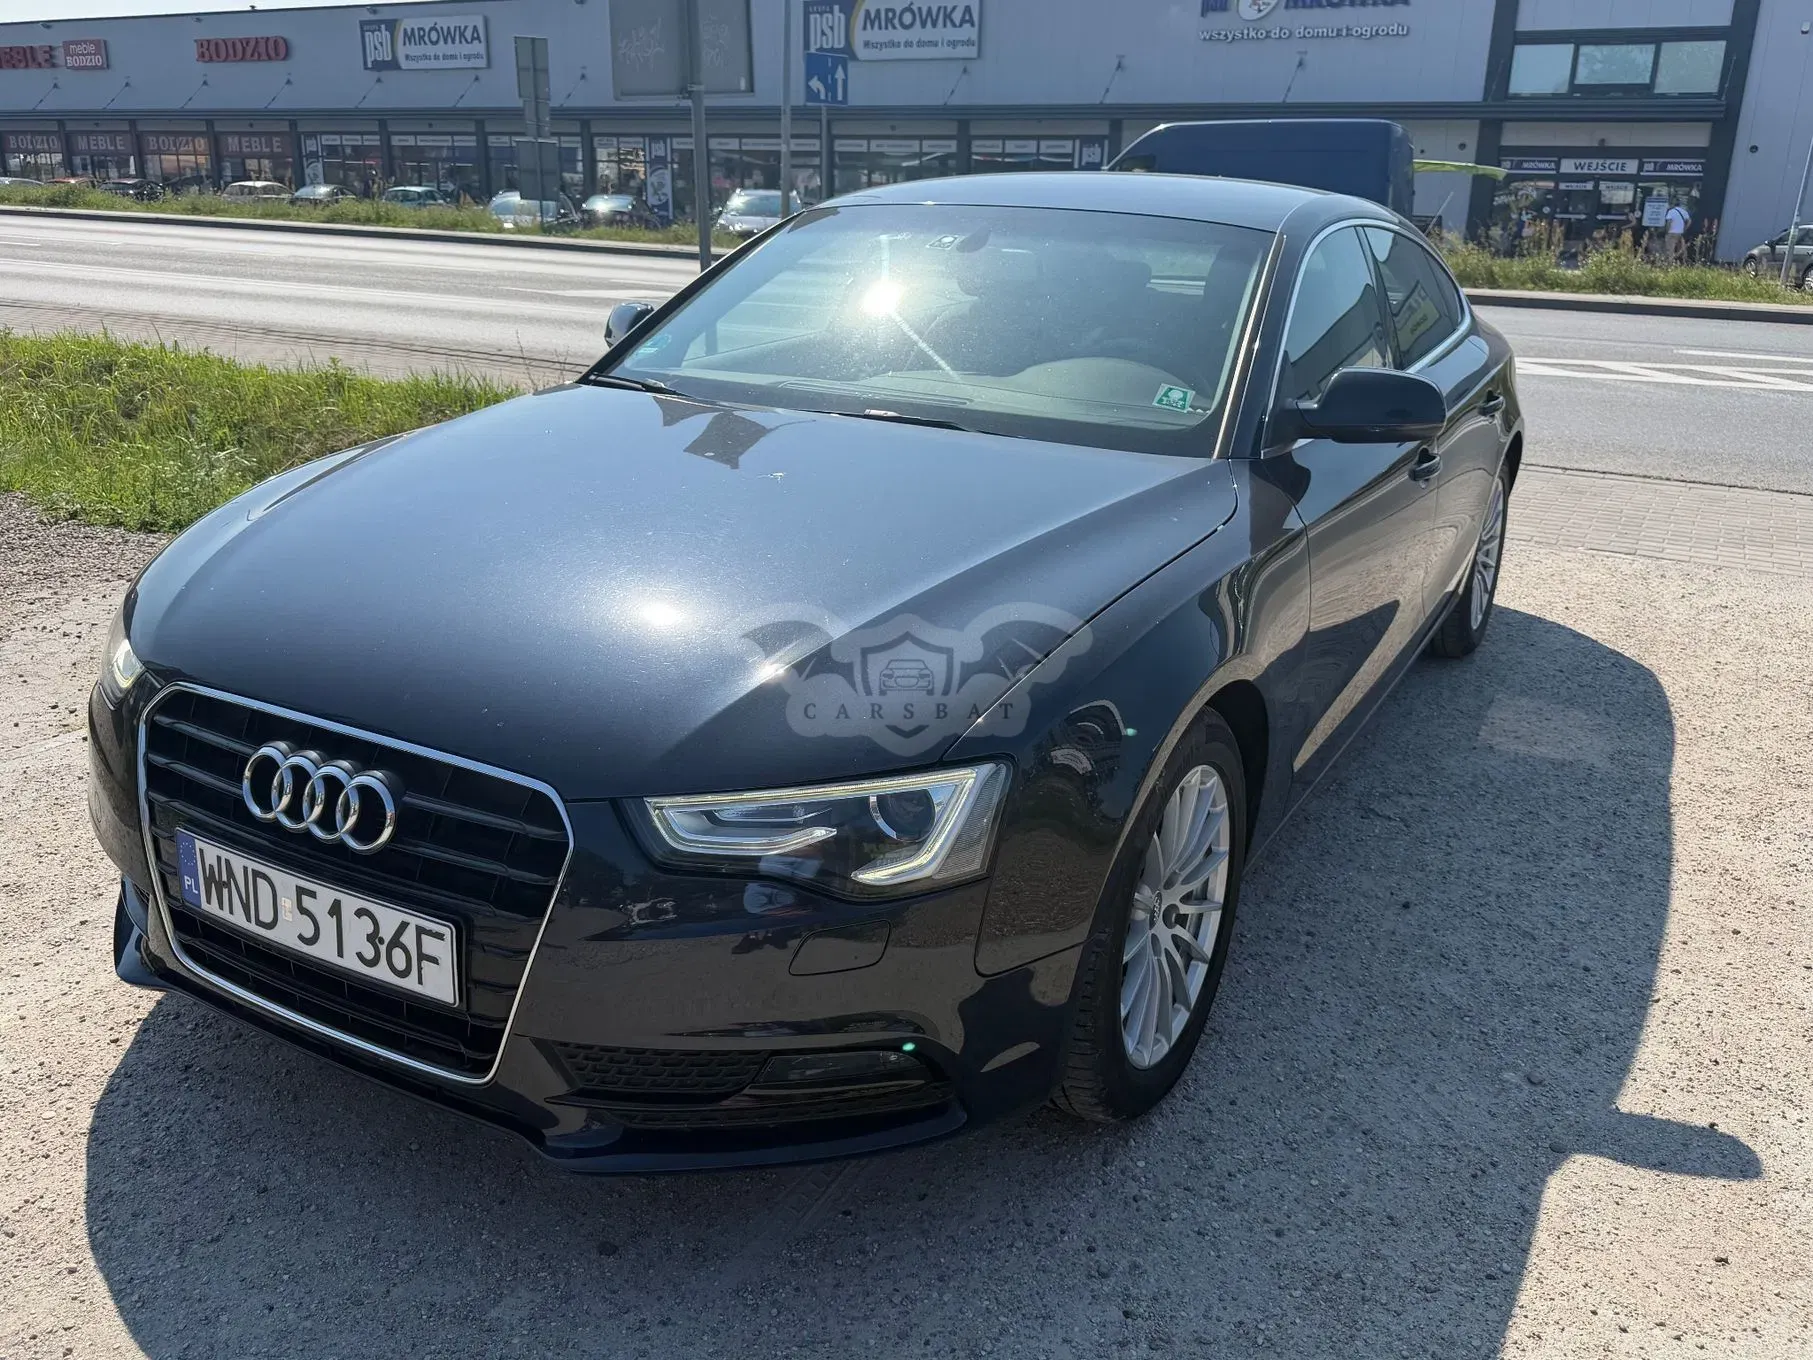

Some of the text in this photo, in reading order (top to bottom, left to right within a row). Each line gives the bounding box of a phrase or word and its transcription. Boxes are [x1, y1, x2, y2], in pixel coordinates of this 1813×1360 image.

[862, 1, 976, 31] MRÓWKA
[402, 21, 482, 47] MRÓWKA
[809, 5, 846, 53] psb
[1199, 27, 1266, 44] wszystko
[1270, 27, 1290, 40] do
[1295, 25, 1337, 39] domu
[1351, 23, 1409, 39] ogrodu
[69, 43, 96, 55] meble
[195, 36, 290, 63] BODZIO
[364, 23, 392, 69] psb
[862, 38, 901, 51] Wszystko
[902, 38, 914, 48] do
[915, 37, 939, 48] domu
[946, 37, 976, 50] ogrodu
[0, 45, 53, 69] EBLE
[66, 55, 102, 67] BODZIO
[77, 135, 126, 151] MEBLE
[227, 136, 283, 154] MEBLE
[1574, 158, 1628, 172] WEJŚCIE
[183, 874, 199, 896] PL
[198, 847, 446, 987] WND 5136F
